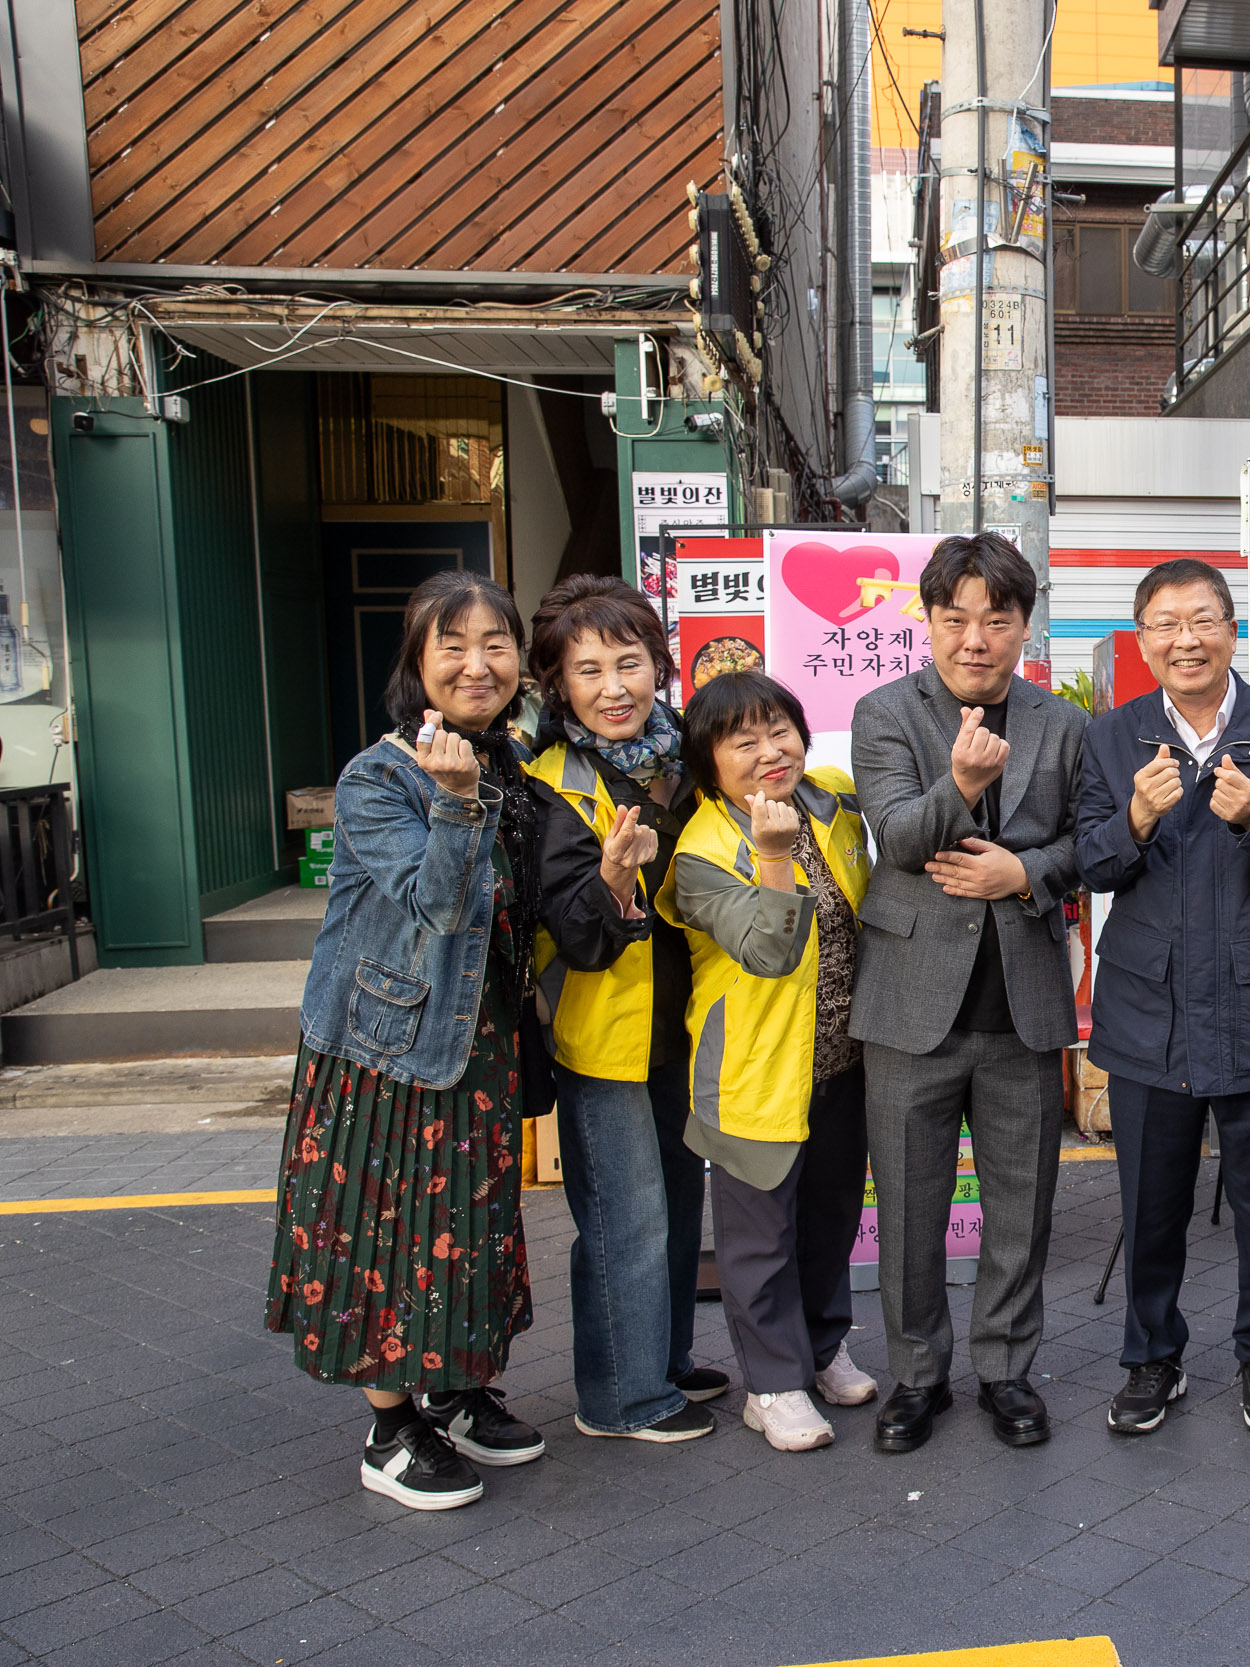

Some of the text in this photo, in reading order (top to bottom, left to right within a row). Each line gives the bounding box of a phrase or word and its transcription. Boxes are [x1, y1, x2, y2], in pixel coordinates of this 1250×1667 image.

[990, 310, 1012, 319] 601
[993, 324, 1014, 345] 11
[638, 486, 723, 505] 별빛의잔
[950, 1218, 982, 1238] 민자
